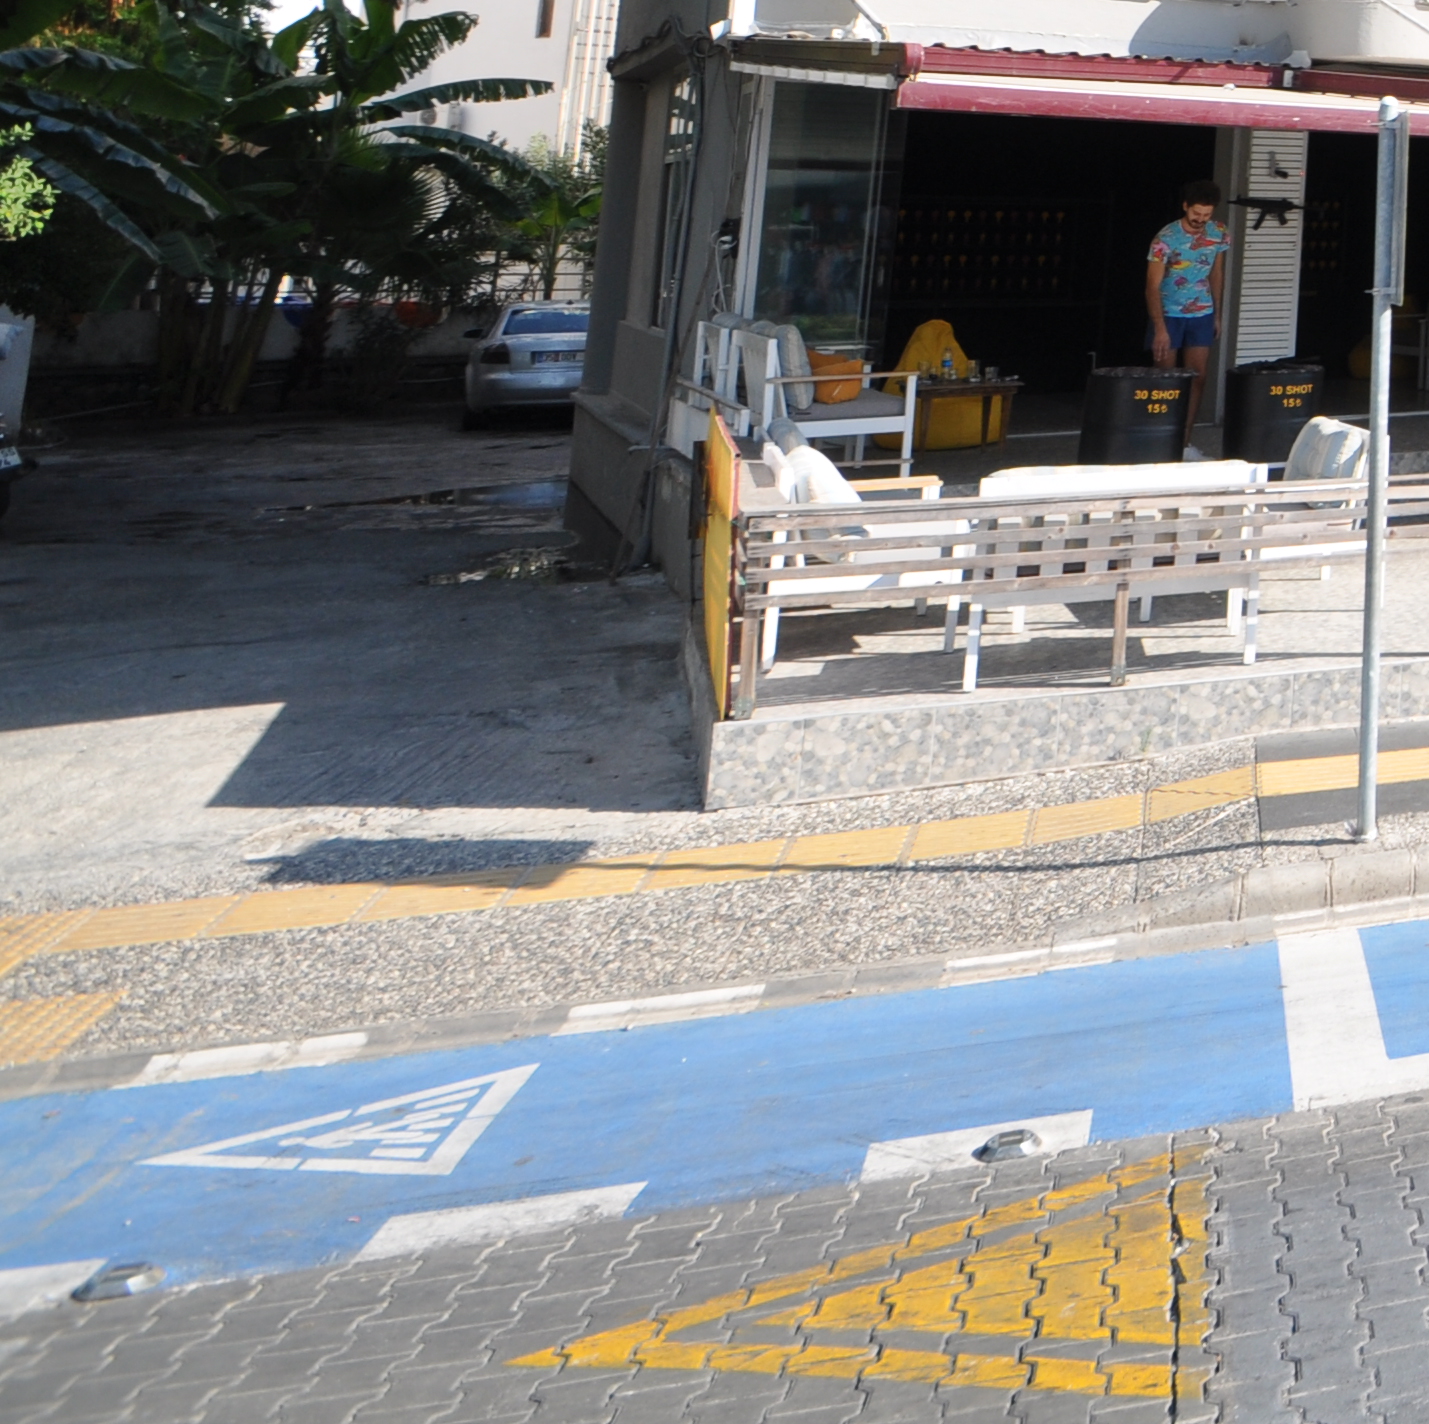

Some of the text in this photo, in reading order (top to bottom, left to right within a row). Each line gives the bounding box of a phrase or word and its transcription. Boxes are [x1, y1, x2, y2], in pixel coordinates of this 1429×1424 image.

[1134, 389, 1181, 400] 30 SHOT
[1269, 384, 1314, 395] 30 SHOT
